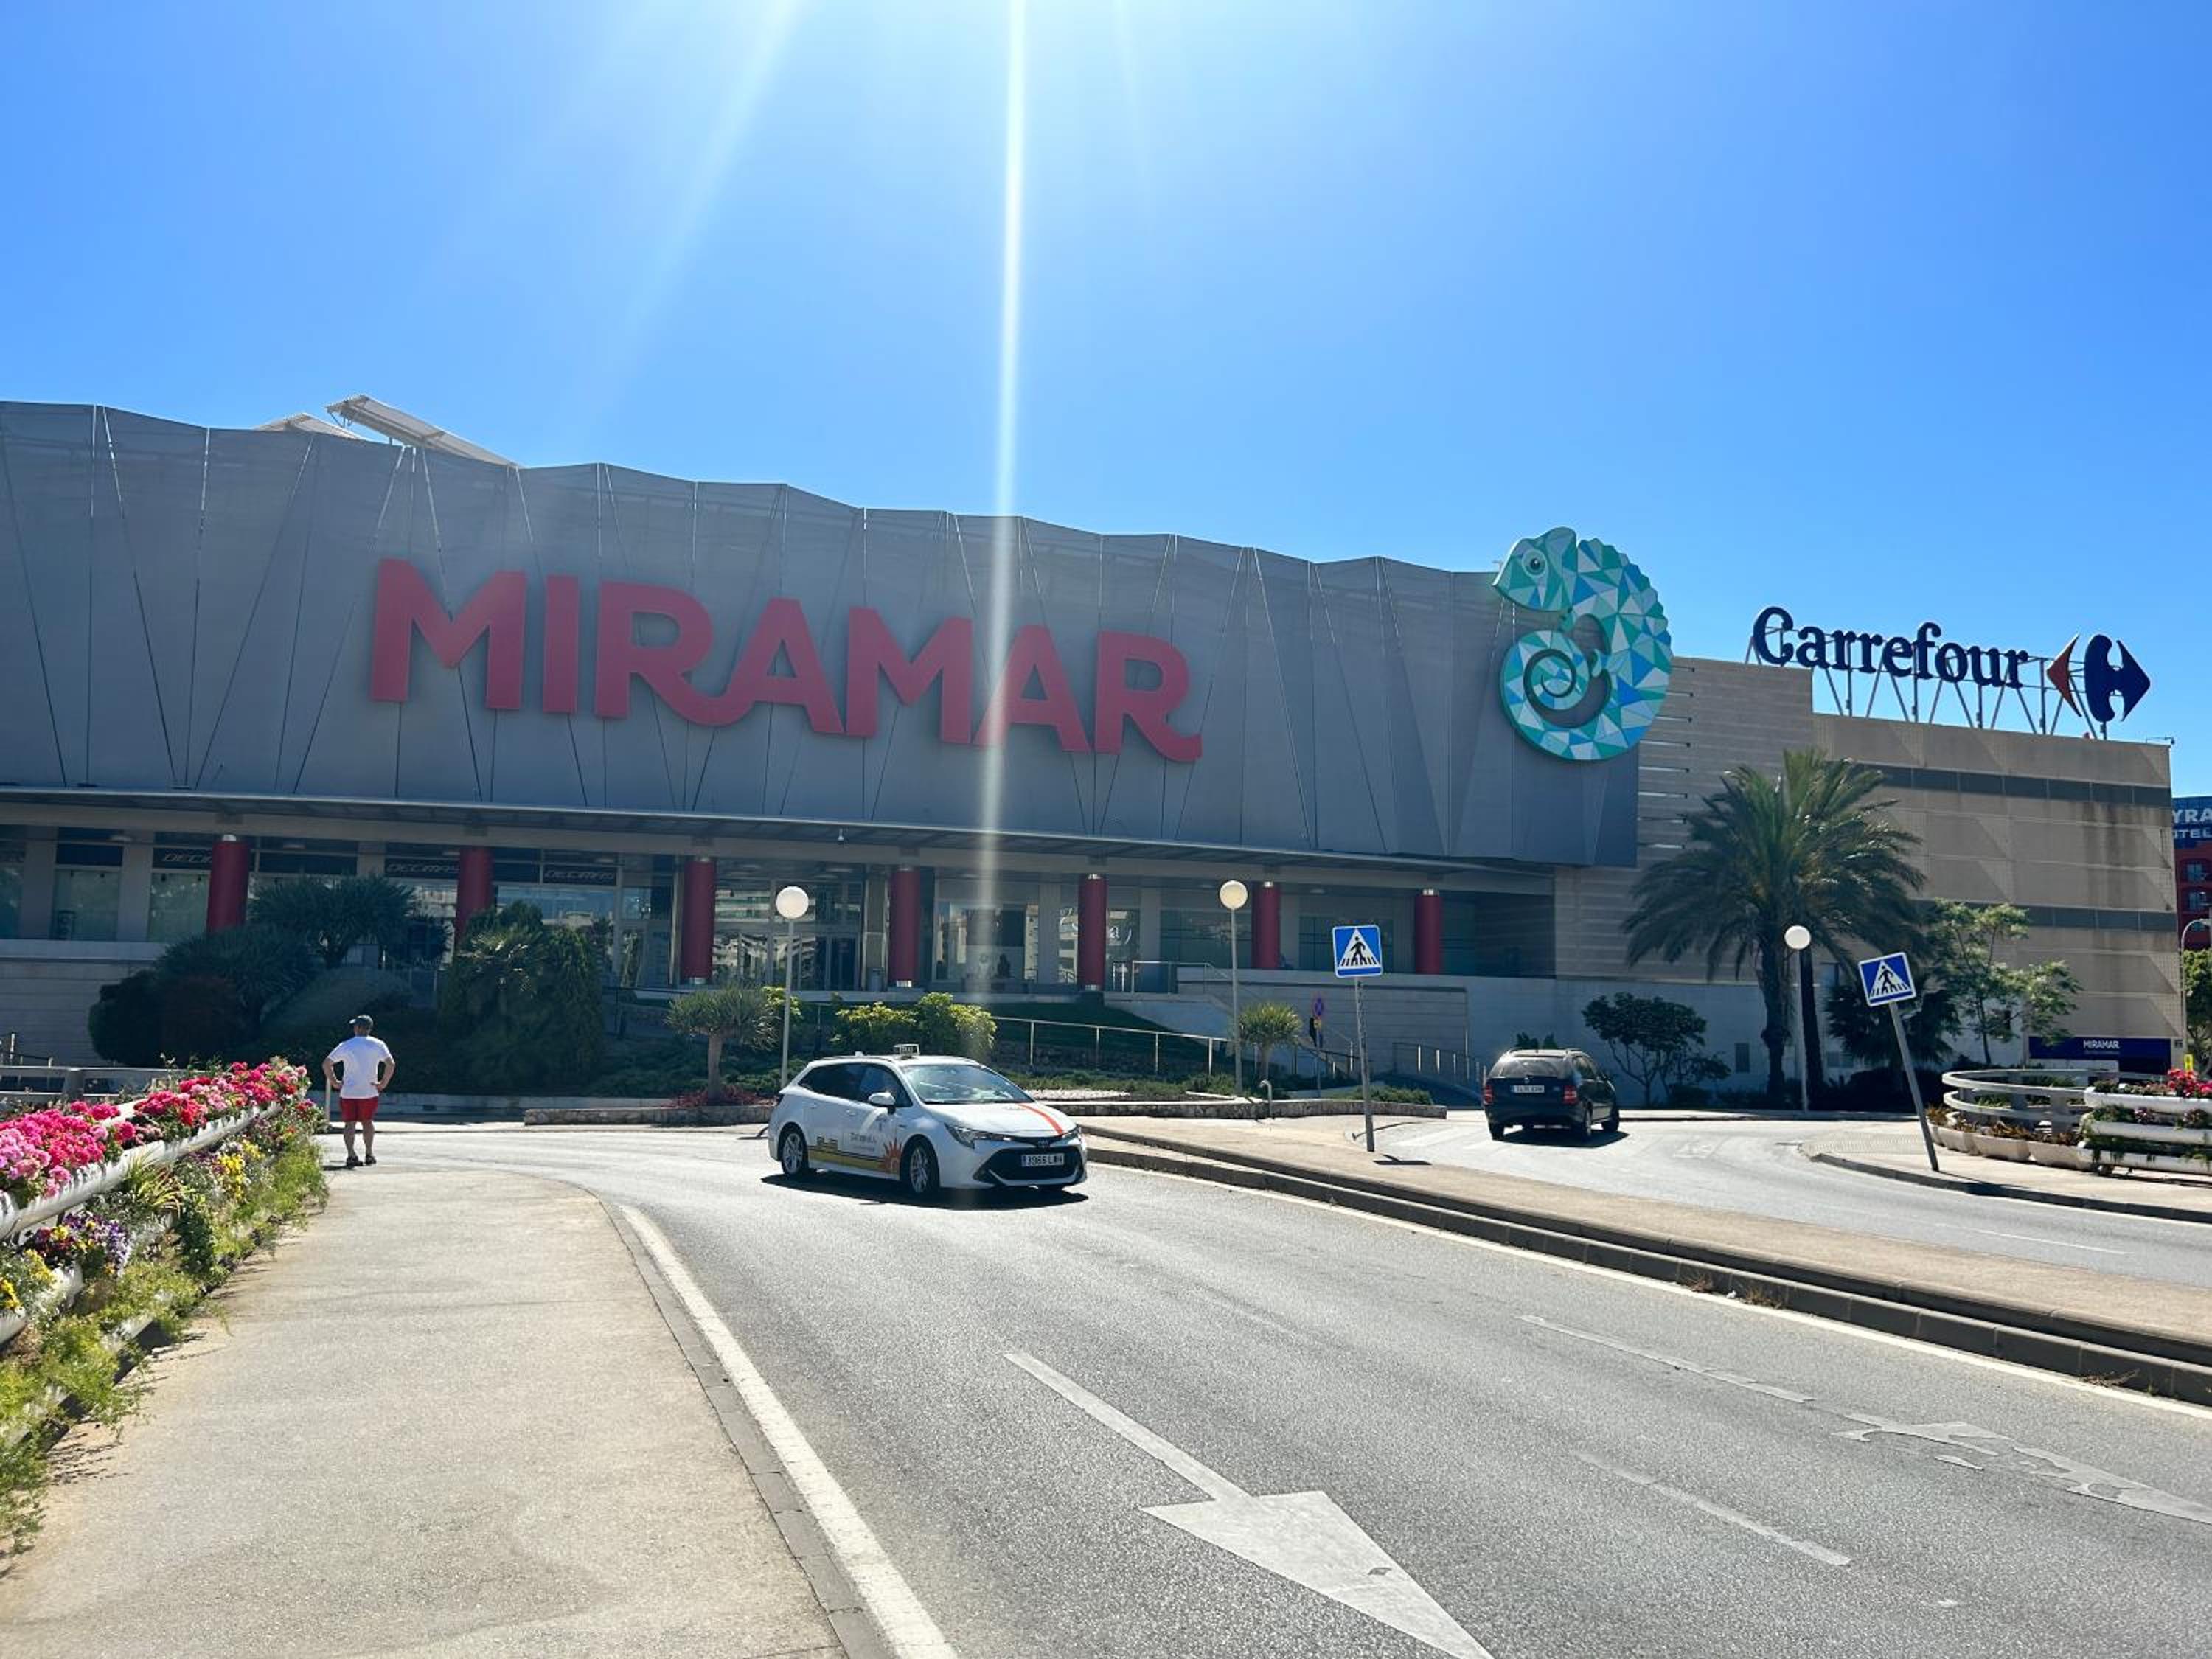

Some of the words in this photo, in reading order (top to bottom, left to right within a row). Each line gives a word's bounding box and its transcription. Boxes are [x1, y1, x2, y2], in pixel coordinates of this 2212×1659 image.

[369, 558, 1203, 763] MIRAMAR
[1753, 606, 2028, 689] Carrefour
[2083, 1040, 2120, 1049] MIRAMAR
